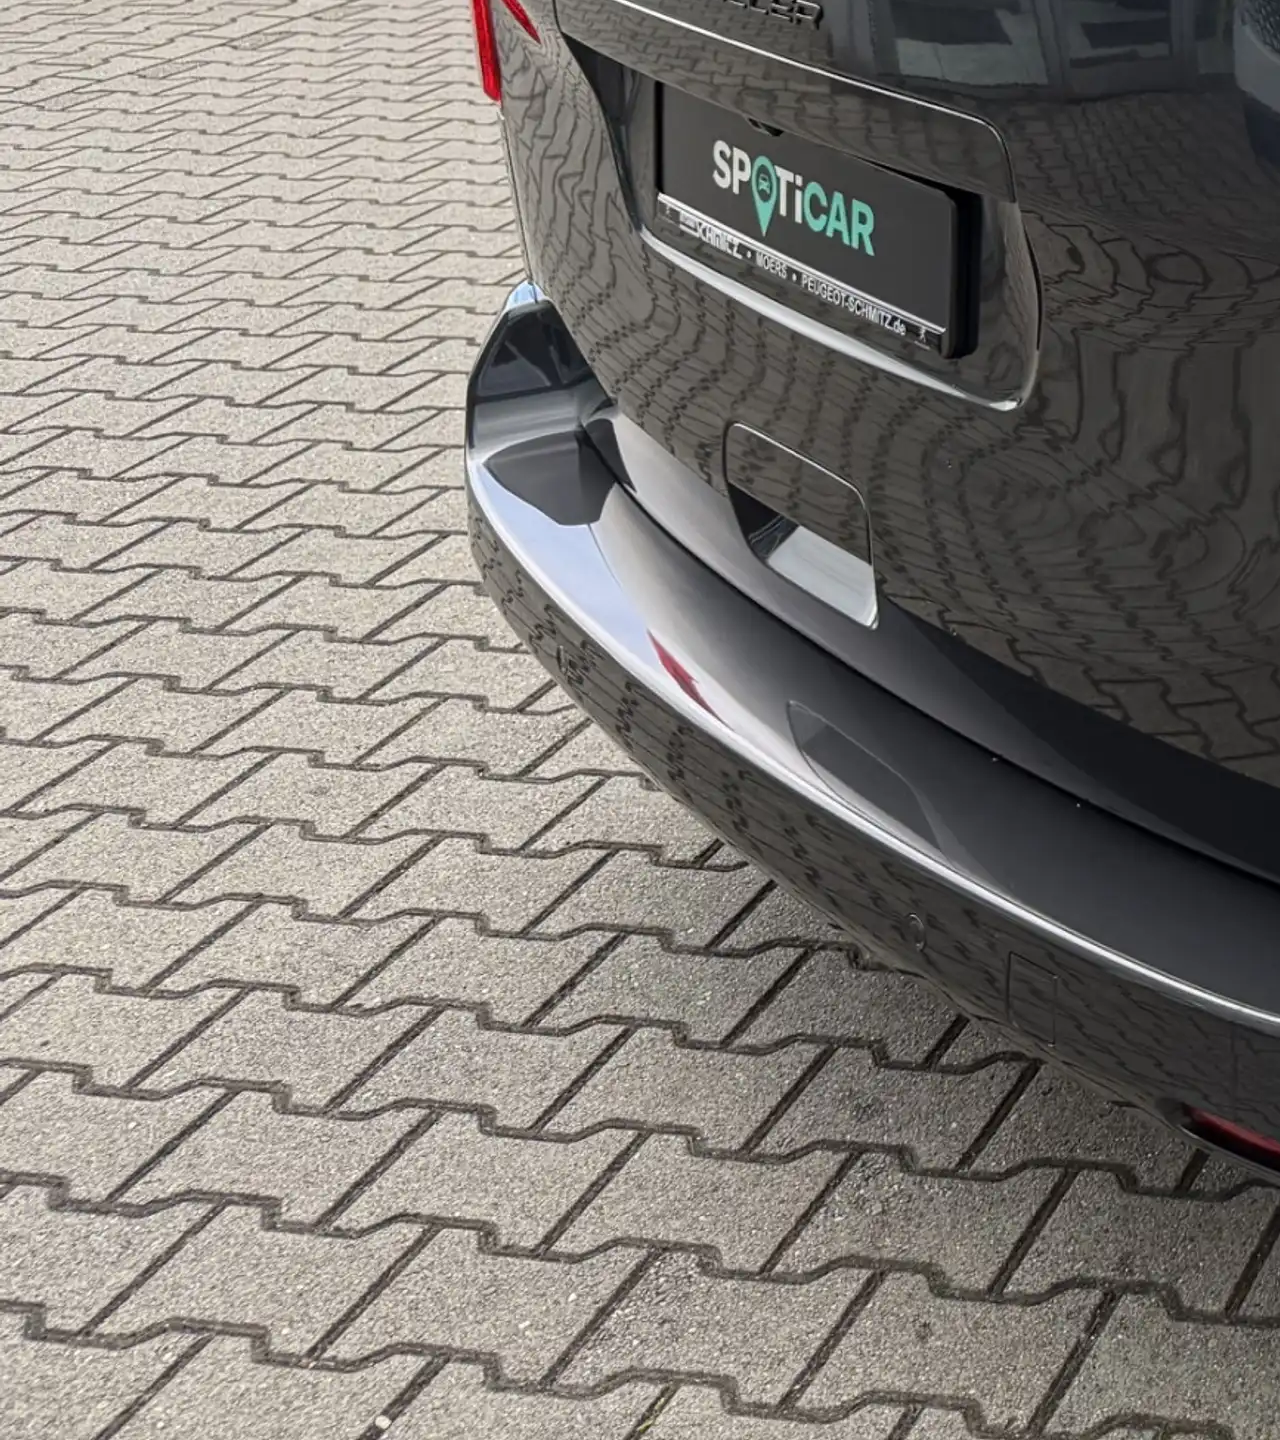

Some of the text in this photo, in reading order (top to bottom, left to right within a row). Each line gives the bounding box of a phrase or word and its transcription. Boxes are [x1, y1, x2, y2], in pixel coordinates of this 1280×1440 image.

[692, 218, 743, 260] SCHMITZ
[755, 250, 788, 280] MOERS
[801, 272, 907, 338] PEUGEOT-SCHMITZ.de
